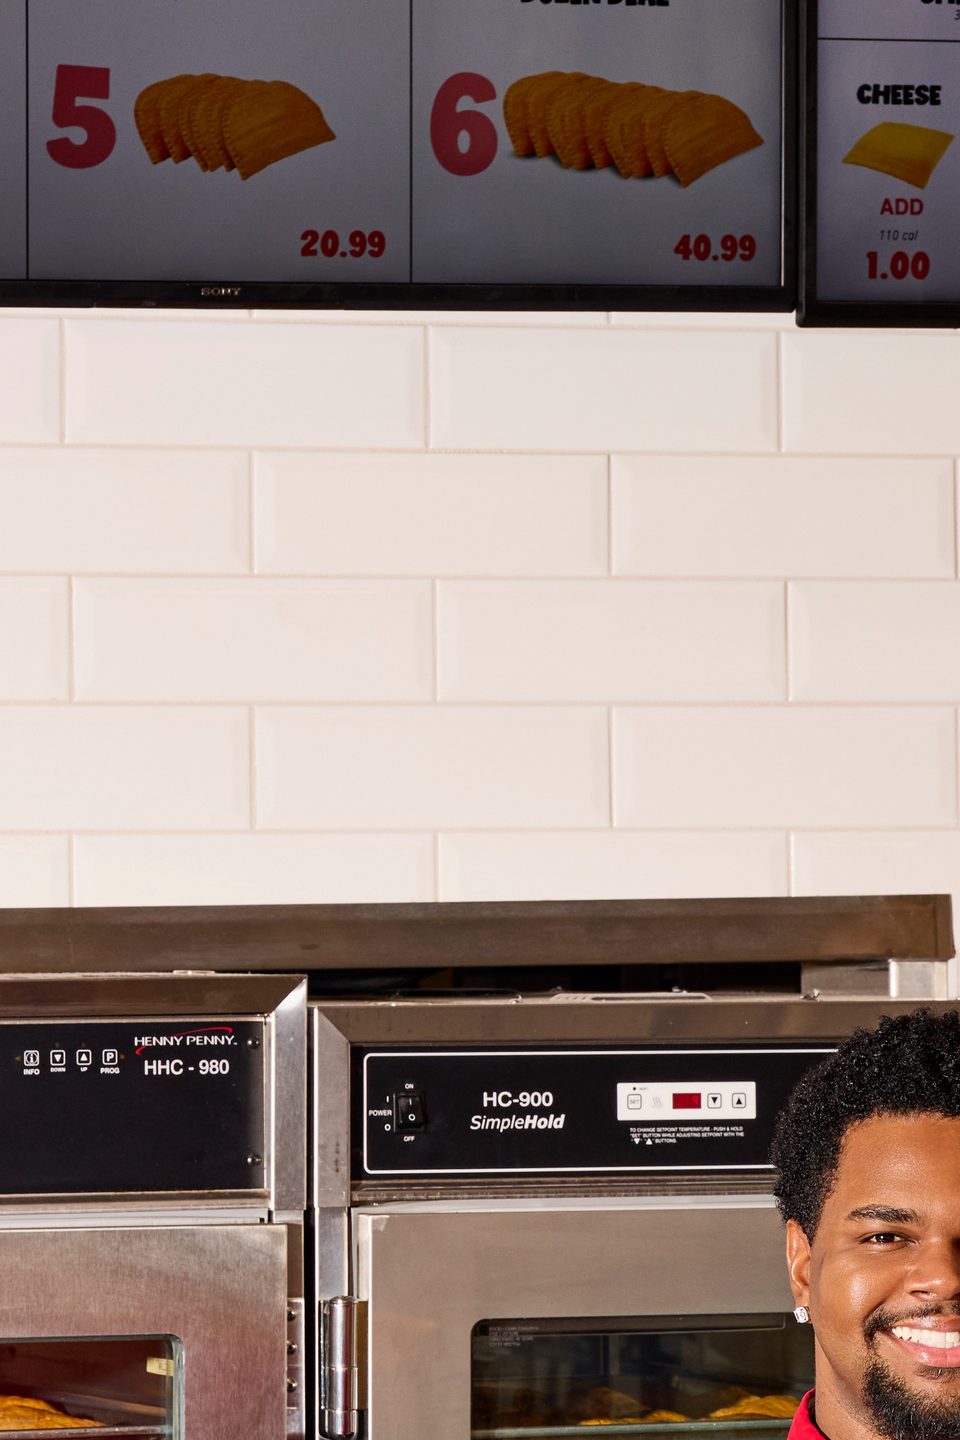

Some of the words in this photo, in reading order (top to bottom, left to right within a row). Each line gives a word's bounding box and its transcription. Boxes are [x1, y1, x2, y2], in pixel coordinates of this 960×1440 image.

[857, 84, 942, 106] CHEESE
[45, 64, 117, 169] 5
[429, 72, 499, 177] 6
[880, 198, 924, 216] ADD
[300, 229, 386, 258] 20.99
[879, 230, 899, 241] 110
[902, 230, 919, 241] cal
[673, 234, 756, 261] 40.99
[866, 251, 930, 280] 1.00
[201, 287, 241, 296] SONY
[134, 1035, 183, 1047] HENNY
[23, 1068, 40, 1076] INFO
[100, 1067, 120, 1075] PROG
[144, 1059, 184, 1076] HHC
[199, 1058, 230, 1075] 980
[482, 1091, 554, 1108] HC-900
[368, 1109, 392, 1117] POWER
[470, 1113, 566, 1133] SimpleHold
[403, 1135, 415, 1143] OFF
